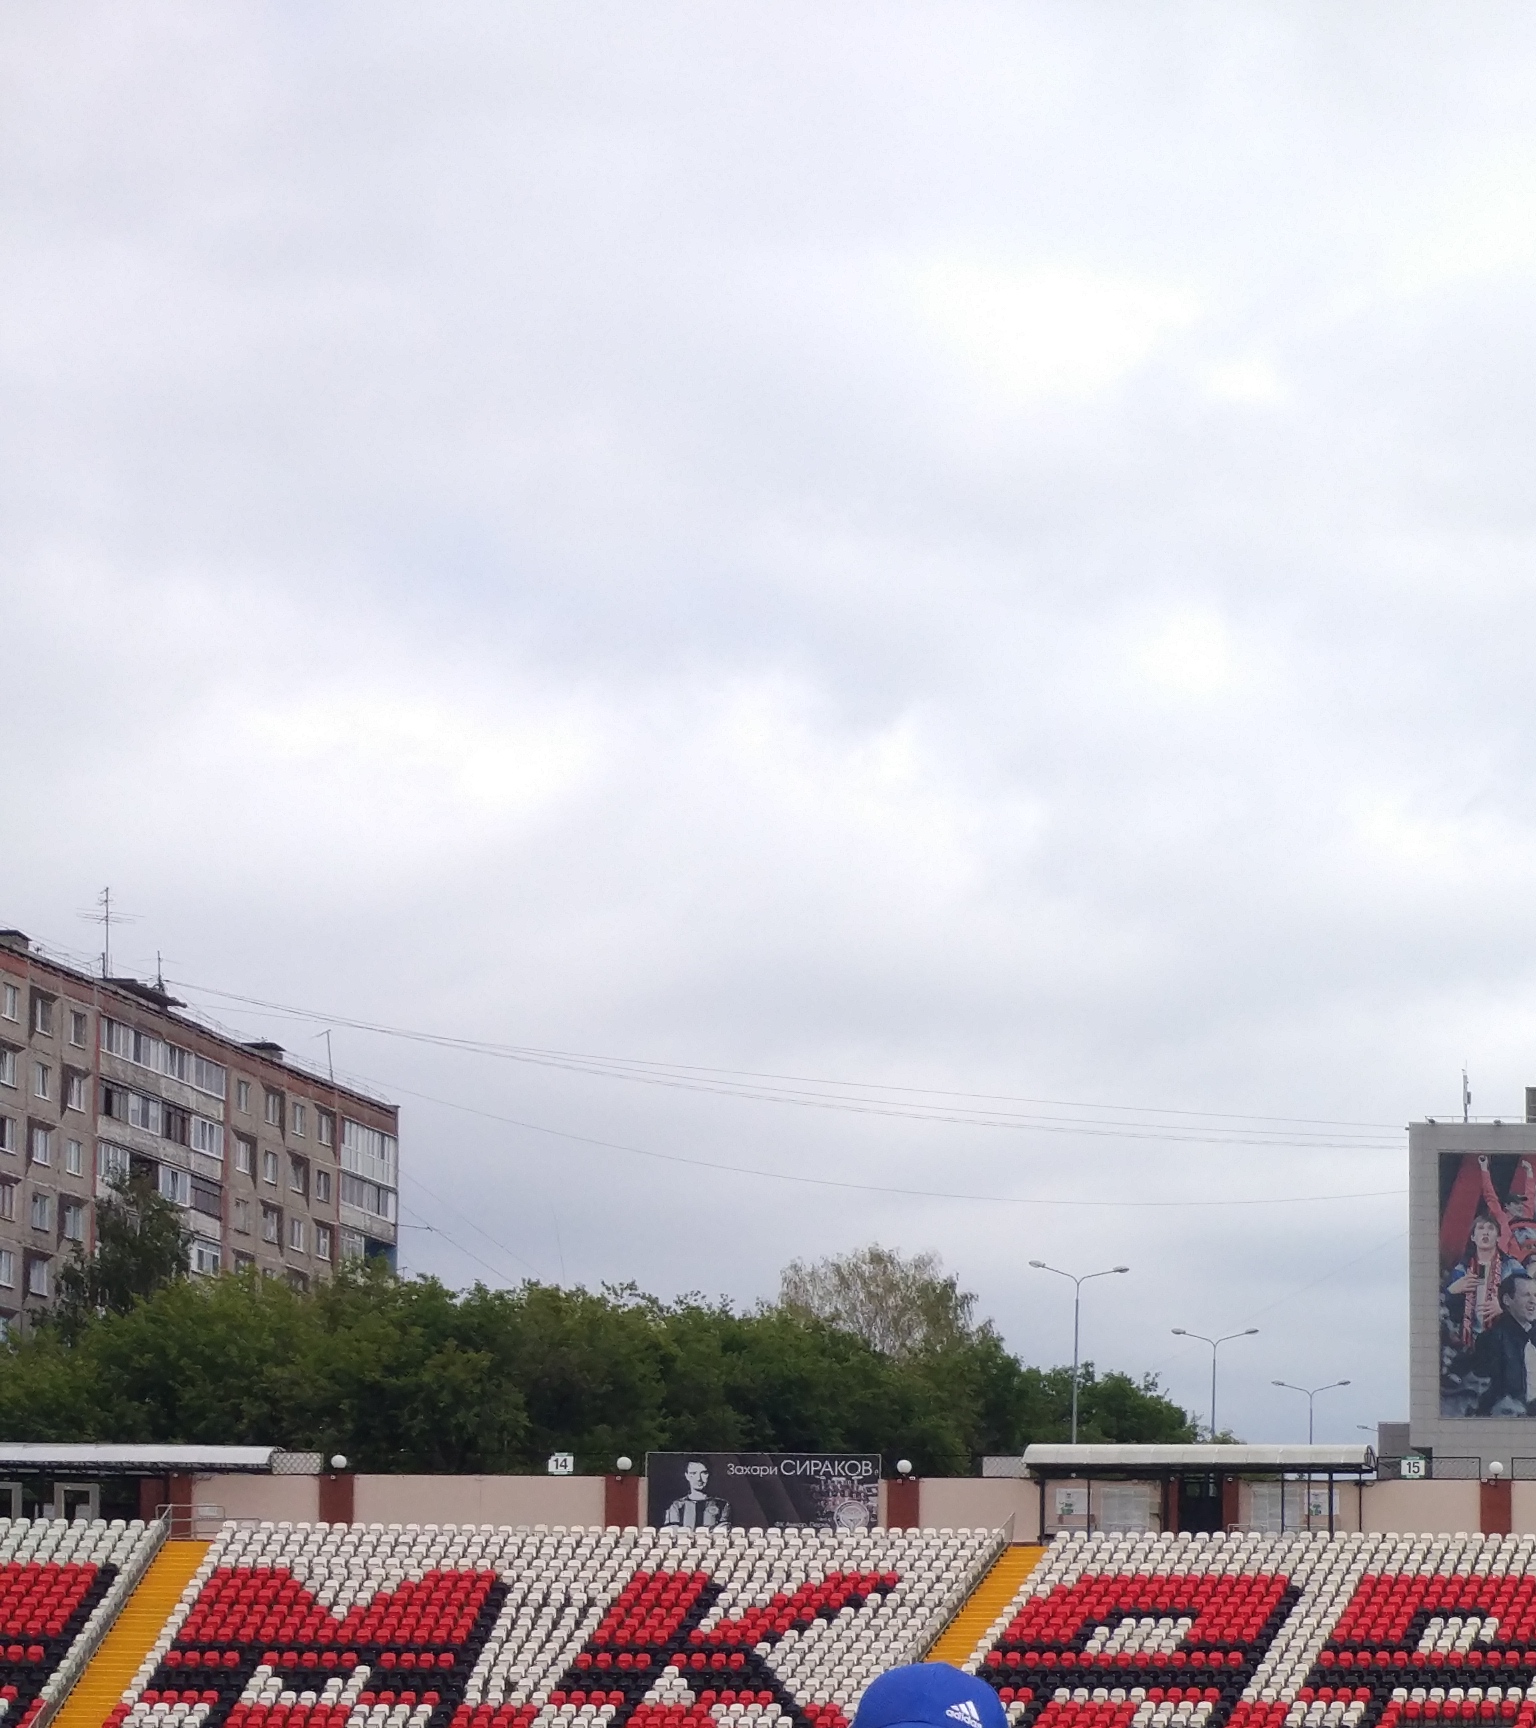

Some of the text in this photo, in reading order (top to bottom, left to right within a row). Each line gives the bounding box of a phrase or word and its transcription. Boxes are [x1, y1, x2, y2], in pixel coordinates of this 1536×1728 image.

[553, 1457, 568, 1470] 14
[727, 1459, 873, 1477] Захари СИРАКОВ
[1406, 1461, 1420, 1473] 15
